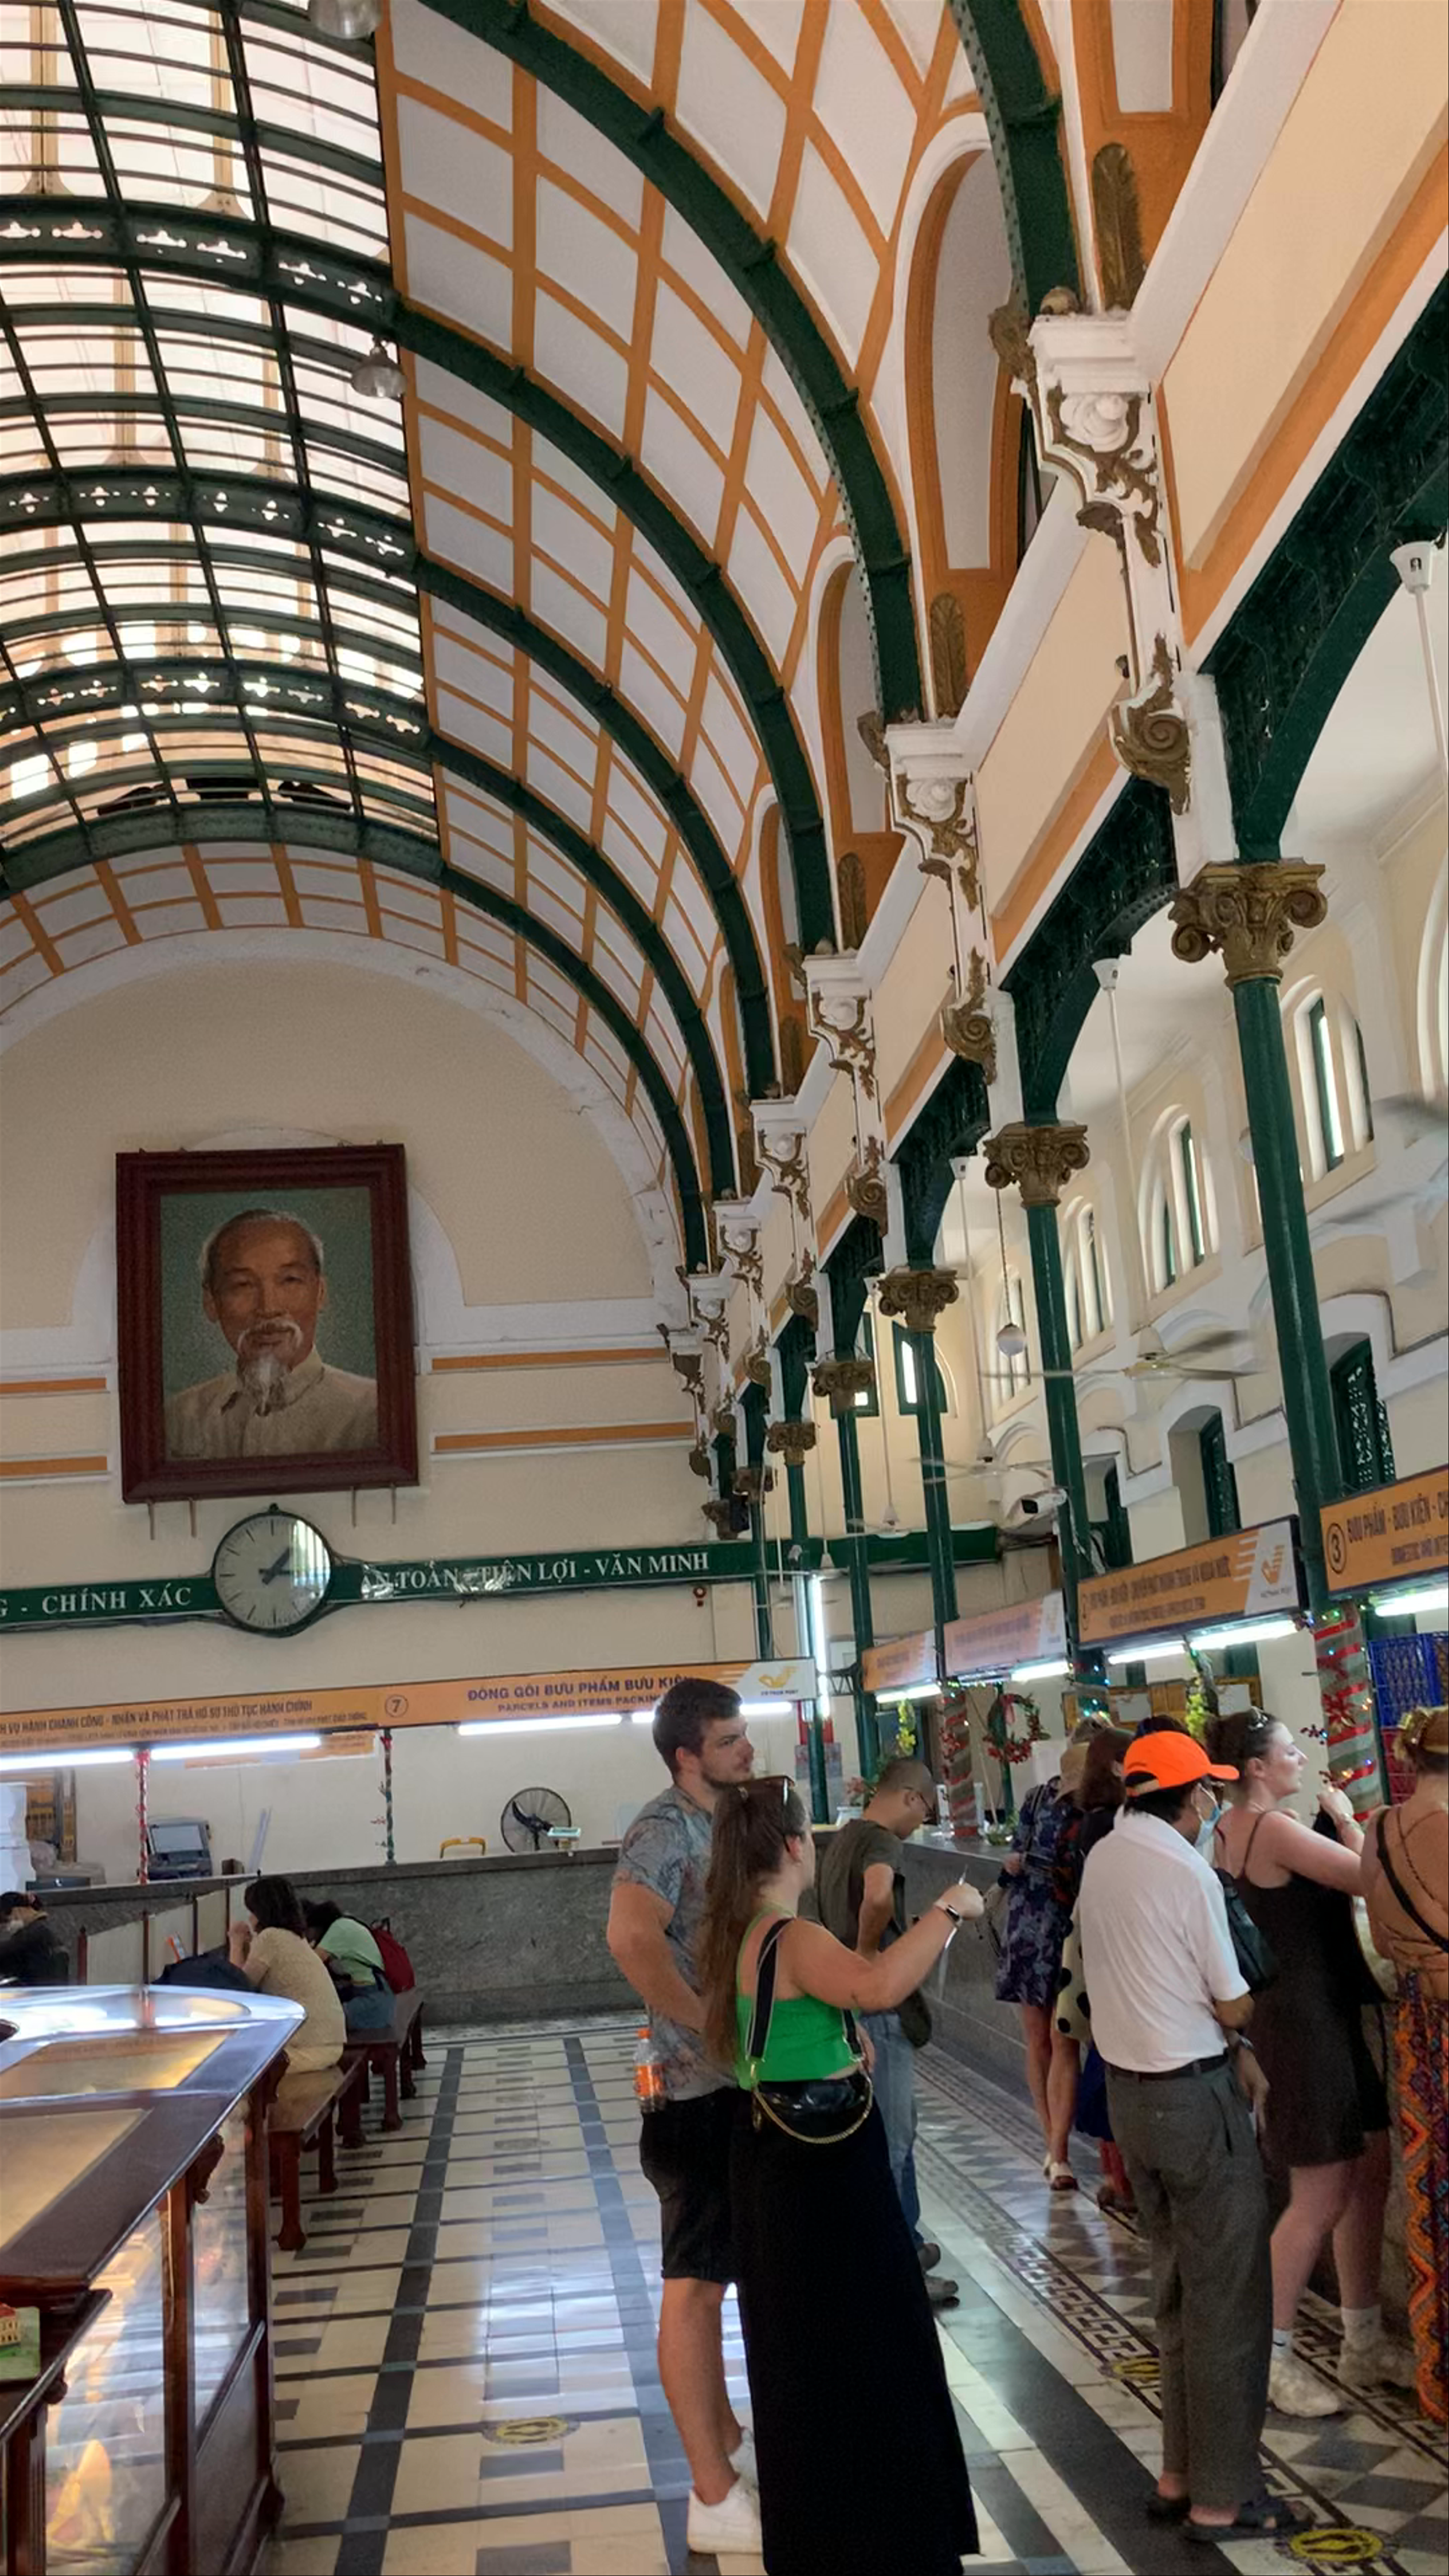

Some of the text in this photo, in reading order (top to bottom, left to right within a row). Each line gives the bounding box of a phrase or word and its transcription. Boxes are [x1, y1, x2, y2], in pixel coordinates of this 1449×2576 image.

[538, 1559, 576, 1583] LỢI
[595, 1553, 642, 1576] VĂN
[648, 1552, 709, 1574] MINH
[42, 1588, 126, 1614] CHÍNH
[139, 1583, 191, 1608] XÁC
[552, 1699, 575, 1709] AND
